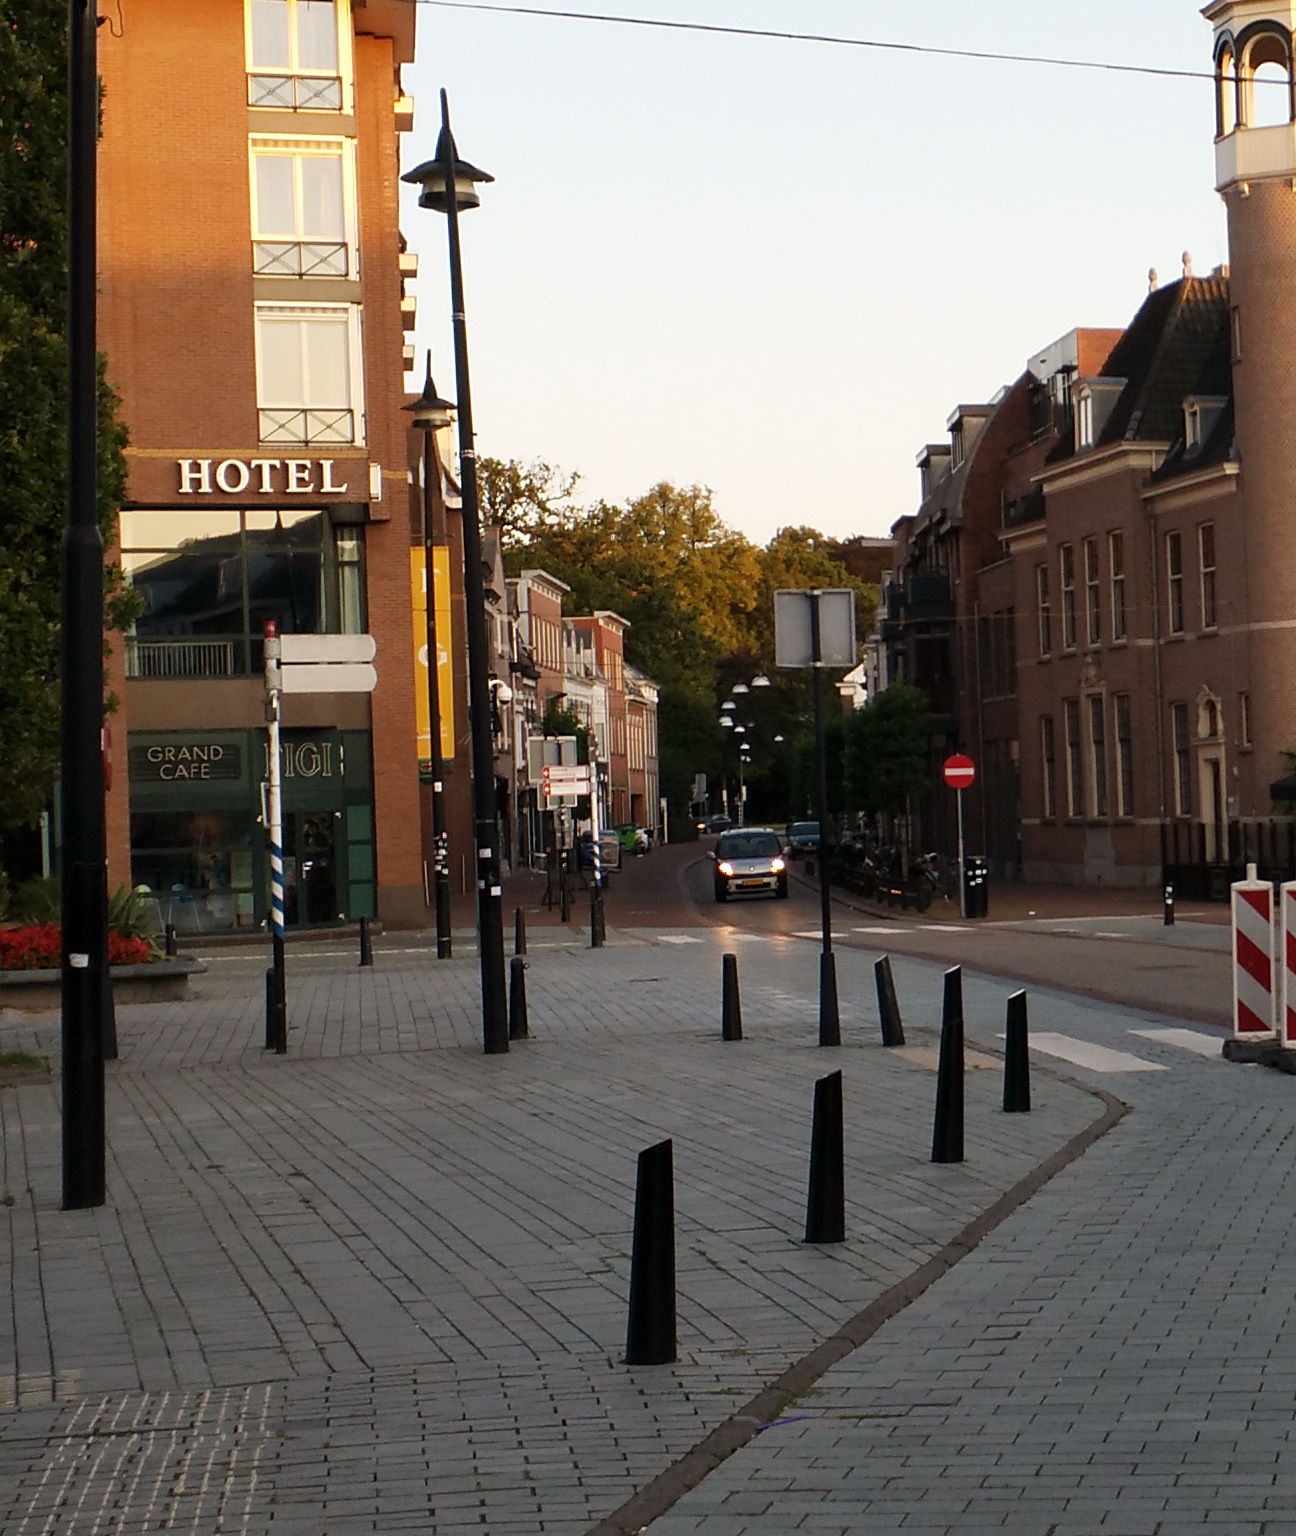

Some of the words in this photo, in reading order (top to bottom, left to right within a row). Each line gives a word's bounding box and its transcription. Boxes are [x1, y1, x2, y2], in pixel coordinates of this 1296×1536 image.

[178, 459, 348, 493] HOTEL
[147, 745, 223, 762] GRAND
[159, 763, 211, 780] CAFE
